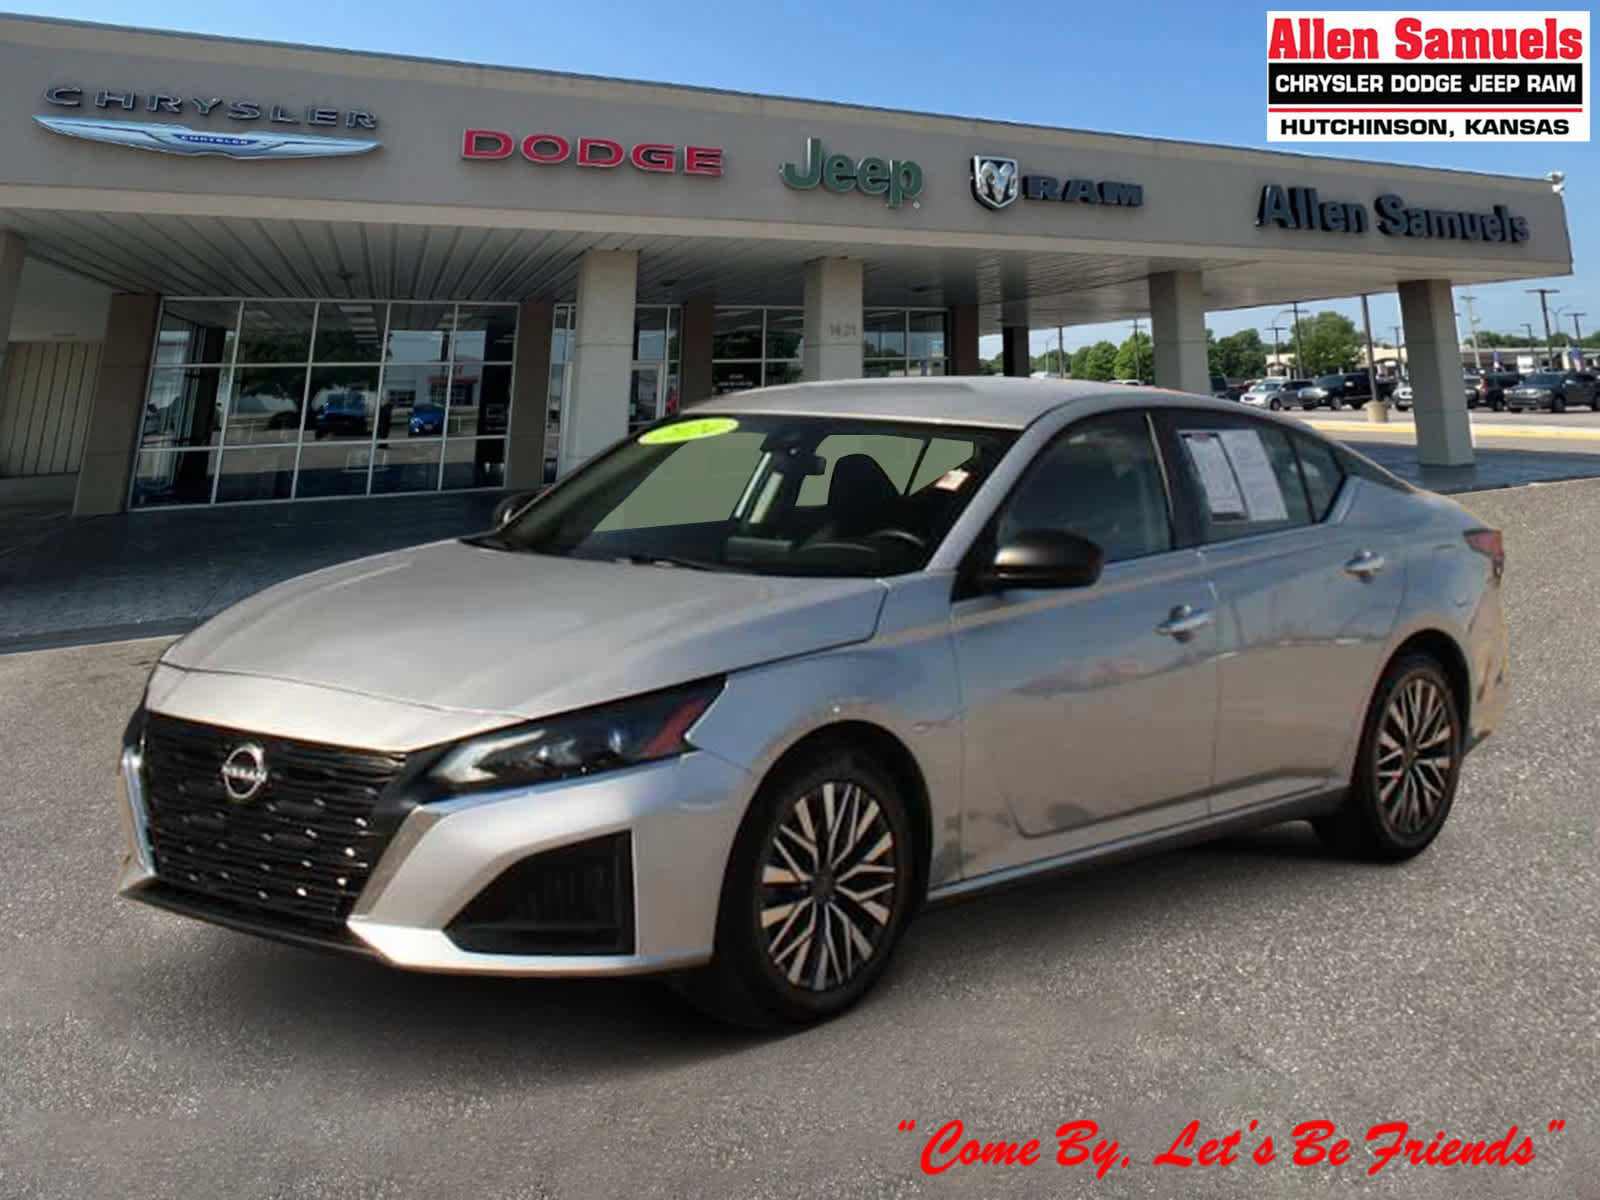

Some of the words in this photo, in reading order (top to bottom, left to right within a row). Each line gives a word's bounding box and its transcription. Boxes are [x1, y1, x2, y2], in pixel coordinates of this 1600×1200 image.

[43, 86, 377, 129] CHRYSLER
[462, 128, 725, 177] DODGE
[779, 137, 923, 208] Jeep
[1022, 174, 1144, 207] RAM
[1256, 184, 1369, 233] Allen
[1375, 193, 1530, 243] Samuels
